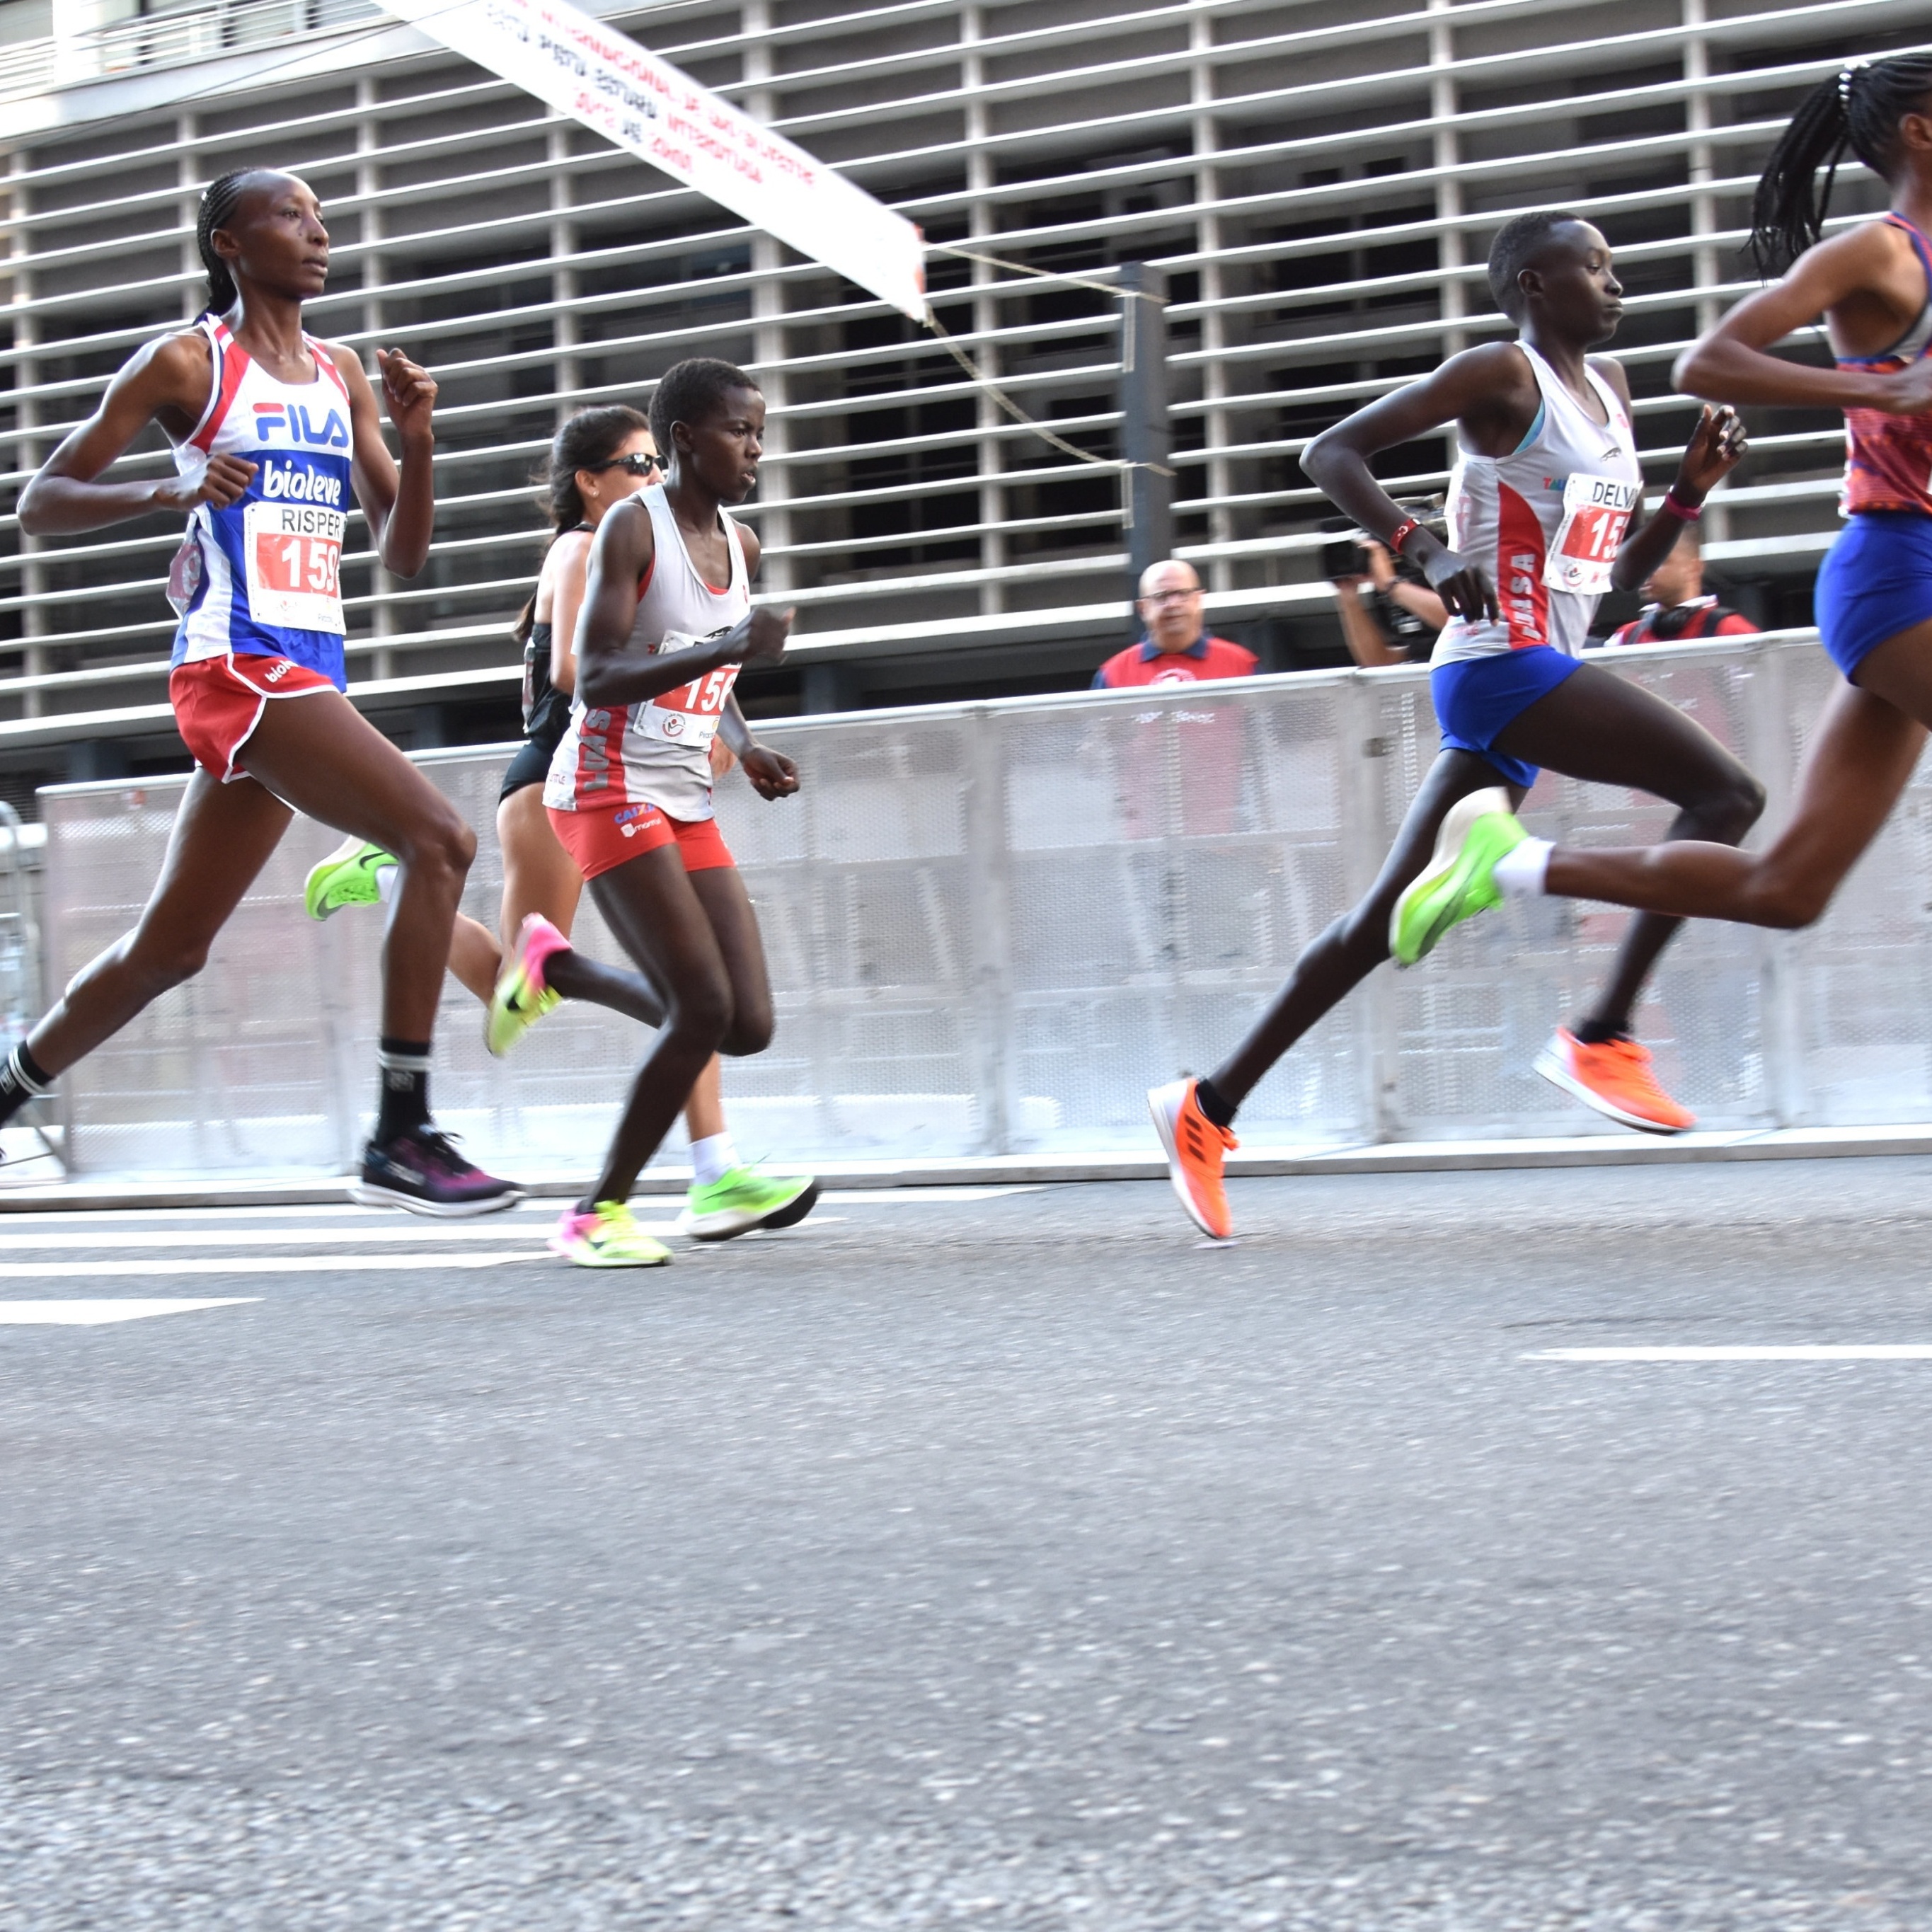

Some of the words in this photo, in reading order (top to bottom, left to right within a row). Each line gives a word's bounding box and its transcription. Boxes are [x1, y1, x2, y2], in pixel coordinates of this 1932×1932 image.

[253, 403, 349, 448] FILA
[263, 459, 341, 506] bioleve
[282, 509, 340, 539] RISPER
